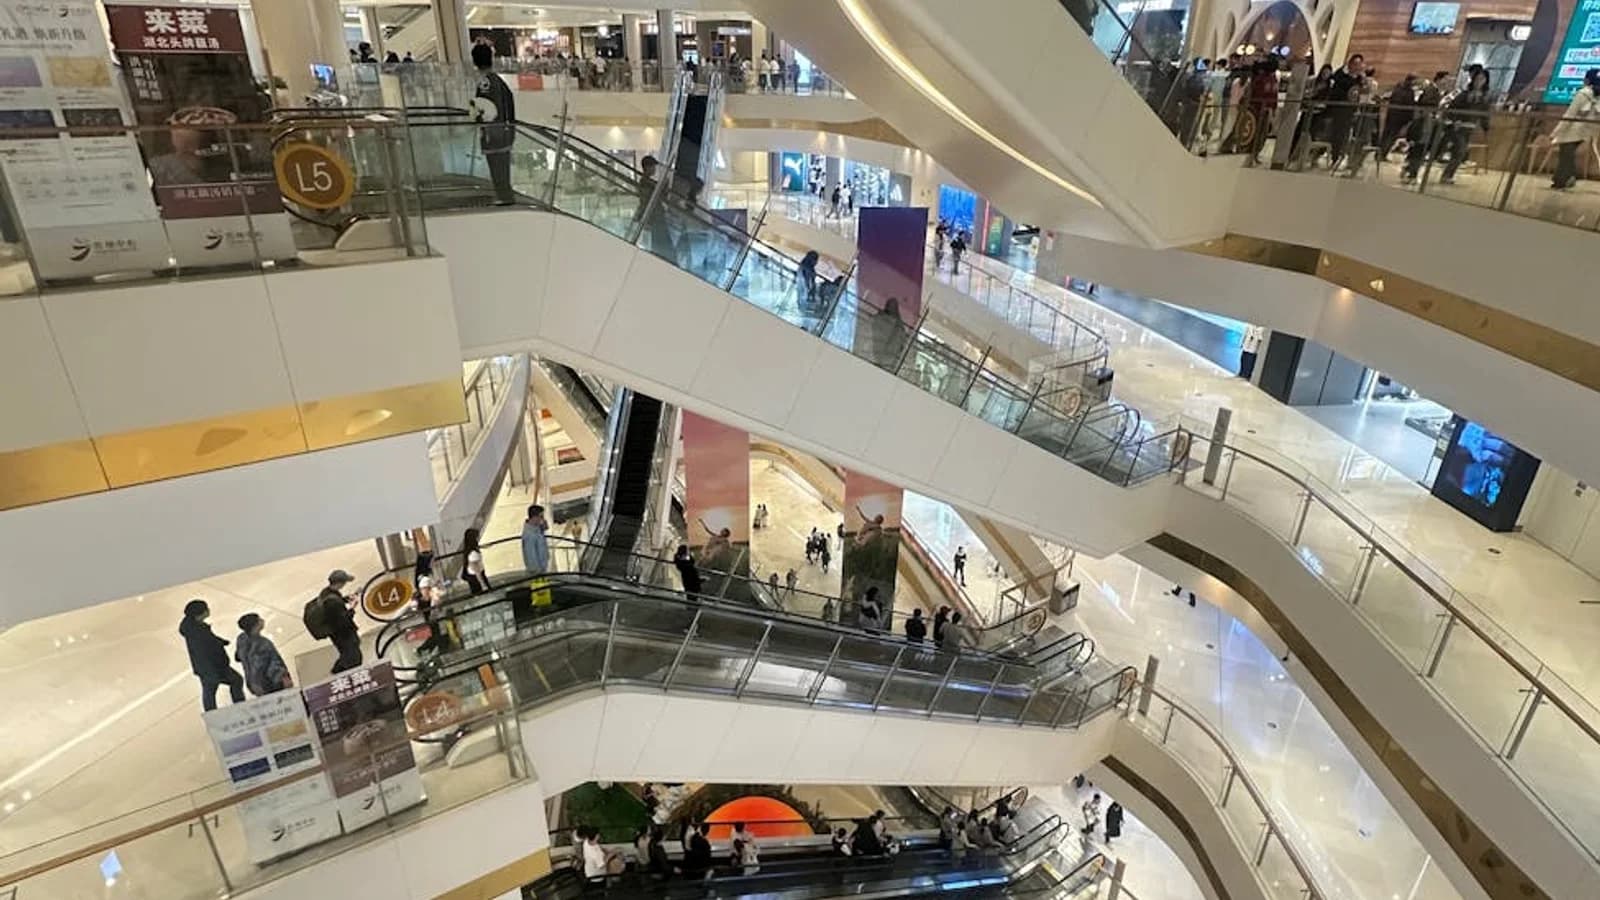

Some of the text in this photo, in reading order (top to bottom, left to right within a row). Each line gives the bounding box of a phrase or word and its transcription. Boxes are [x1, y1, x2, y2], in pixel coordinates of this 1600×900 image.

[145, 8, 209, 34] 来菜
[295, 161, 333, 193] L5
[377, 586, 400, 608] L4
